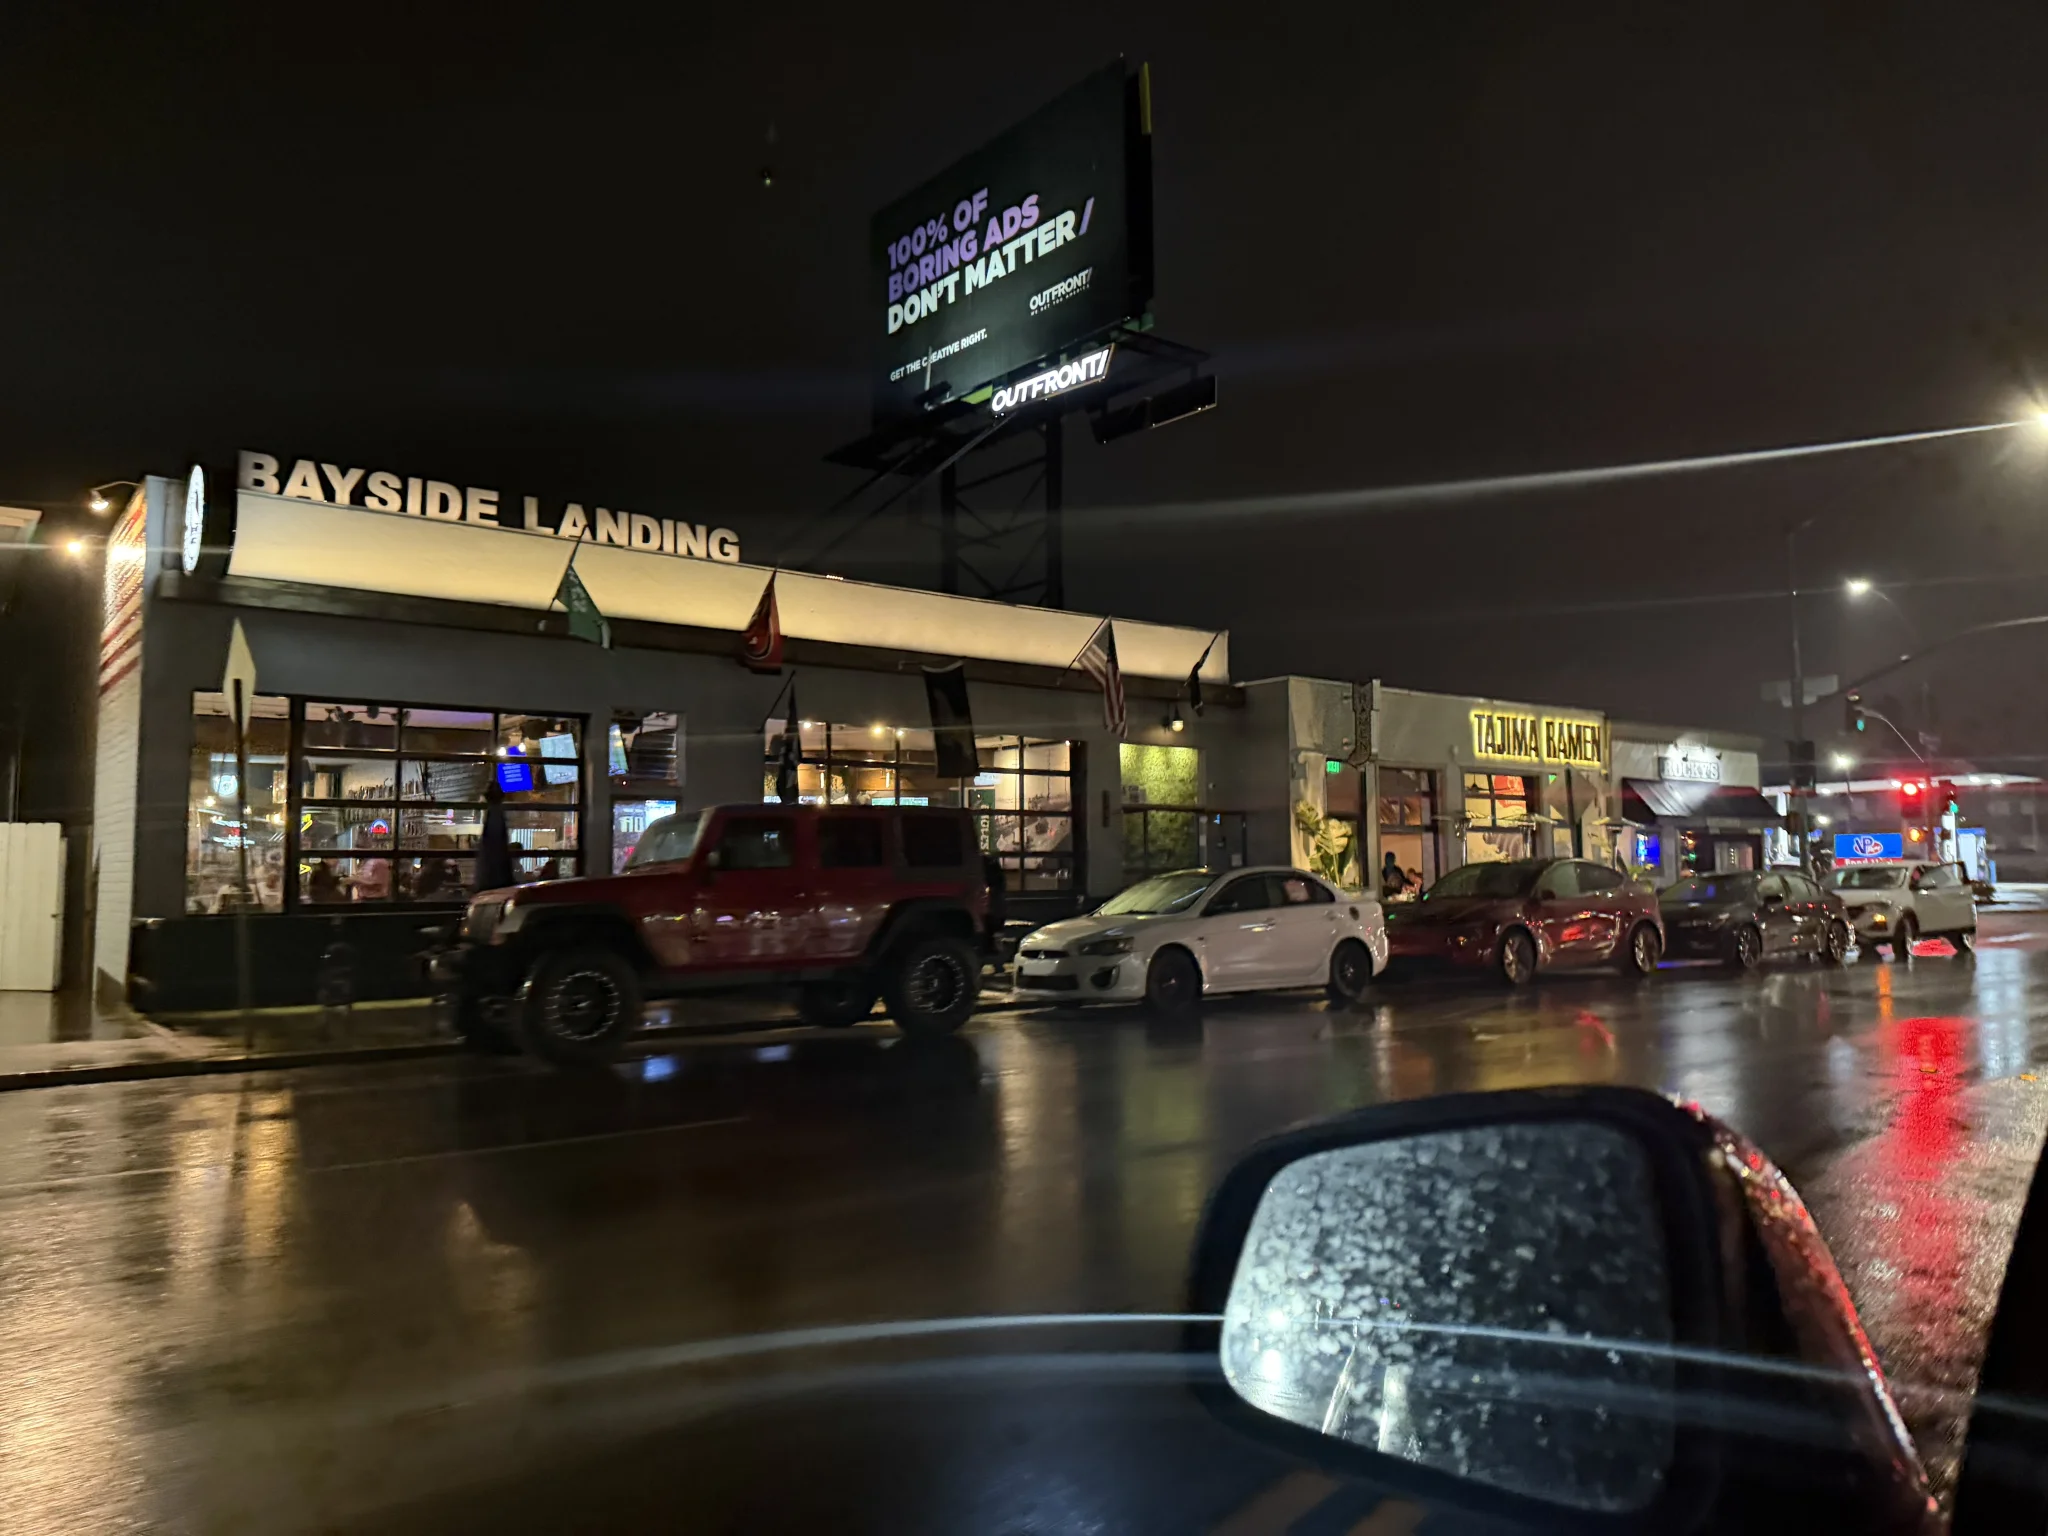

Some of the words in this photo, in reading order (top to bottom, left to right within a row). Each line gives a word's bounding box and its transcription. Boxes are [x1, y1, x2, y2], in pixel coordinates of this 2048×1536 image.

[888, 212, 948, 271] 100%
[953, 187, 988, 232] OF
[888, 229, 978, 303] BORING
[983, 194, 1039, 252] ADS
[888, 271, 960, 335] DON'T
[965, 210, 1077, 295] MATTER
[890, 367, 905, 382] GET
[906, 360, 921, 375] THE
[960, 328, 988, 350] RIGHT.
[238, 450, 499, 527] BAYSIDE
[524, 496, 740, 563] LANDING
[1474, 713, 1540, 758] TAJIMA
[1545, 720, 1601, 762] RAMEN
[1664, 759, 1719, 780] ROCKY'S
